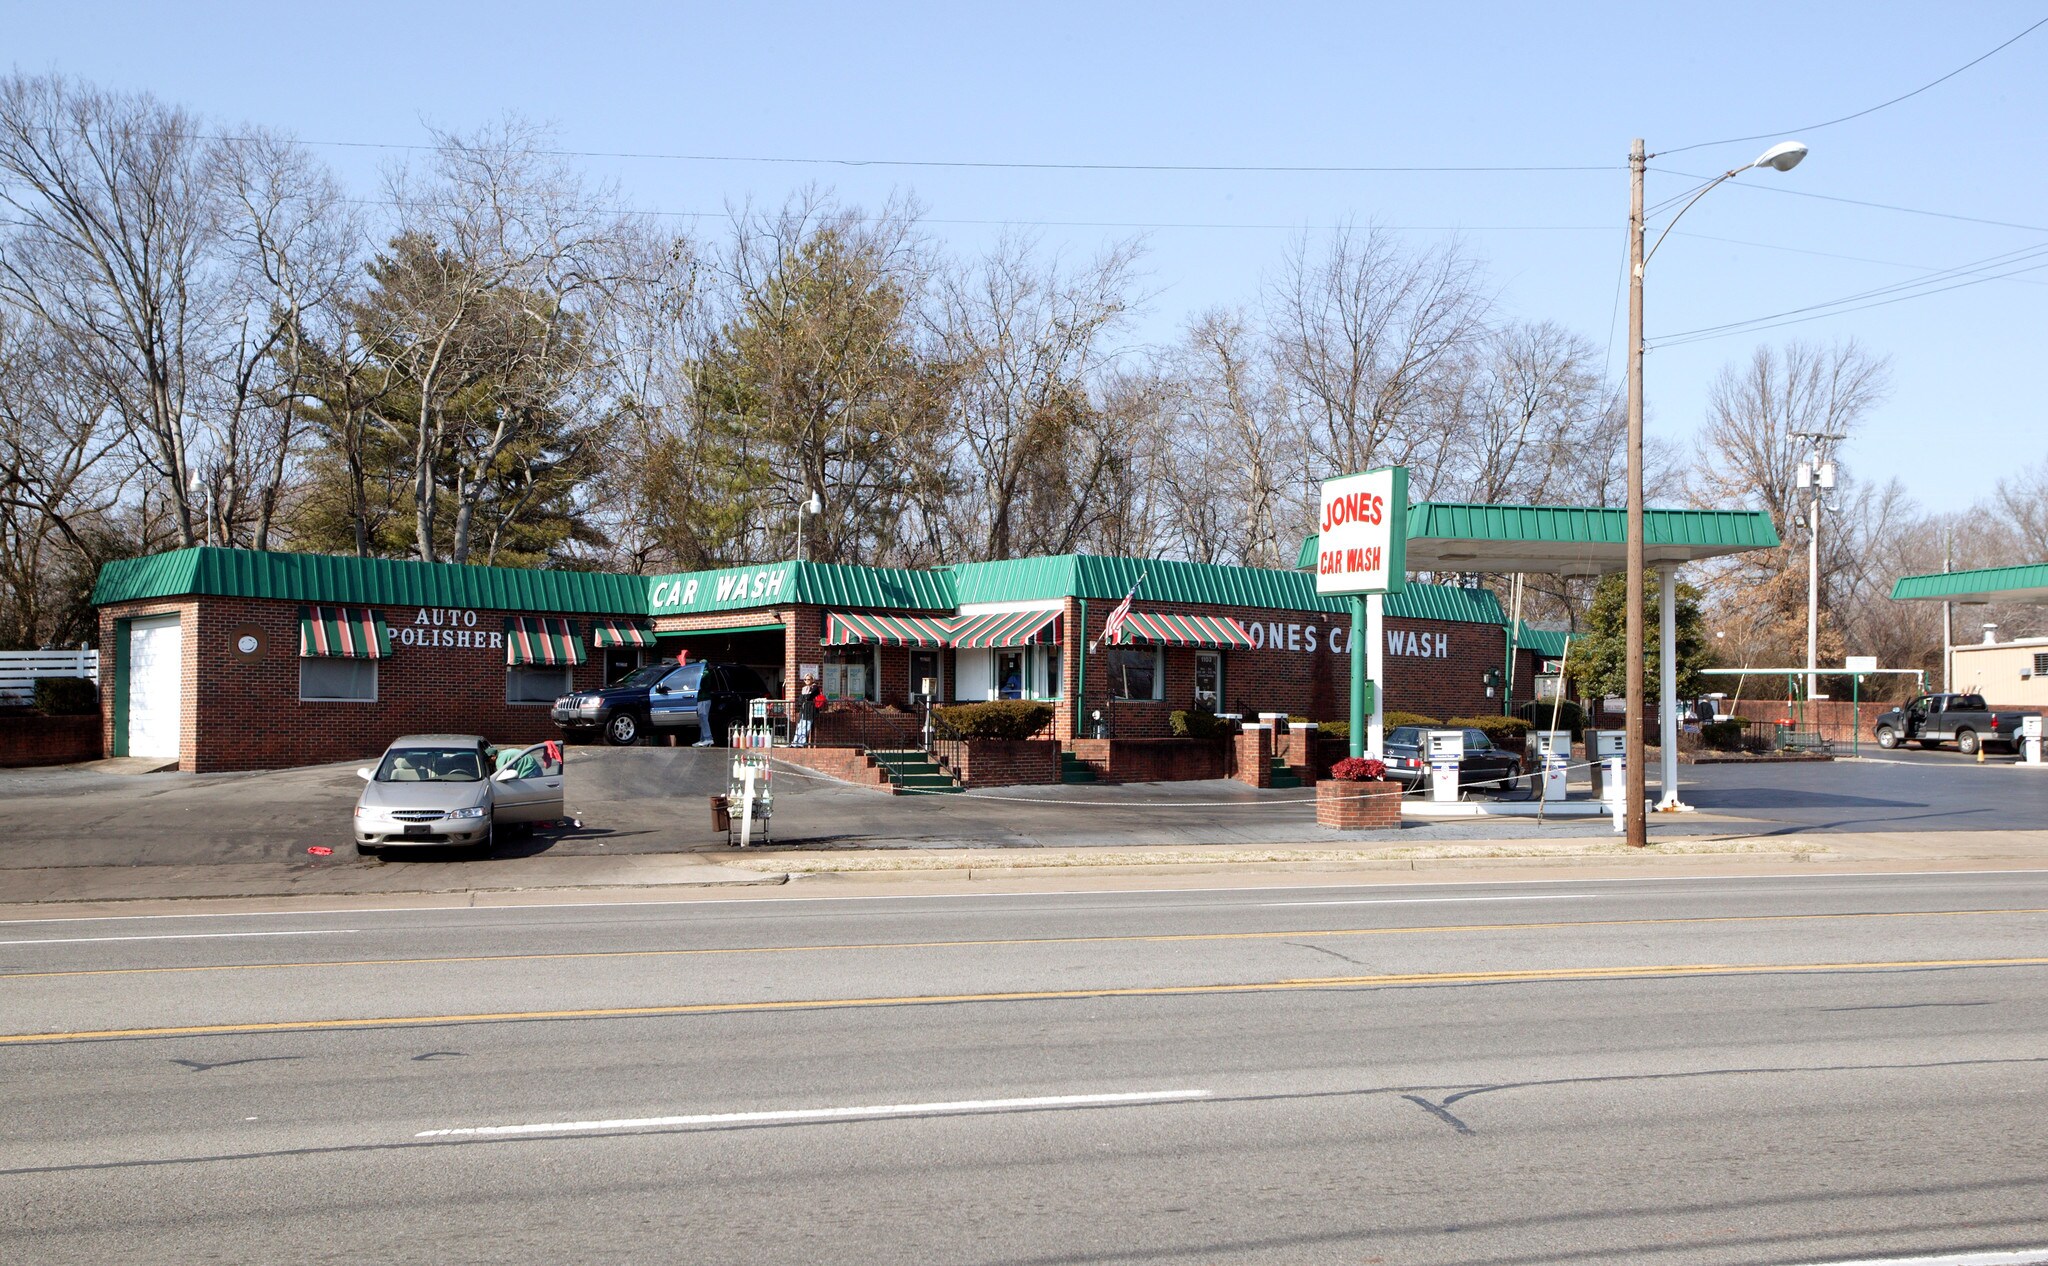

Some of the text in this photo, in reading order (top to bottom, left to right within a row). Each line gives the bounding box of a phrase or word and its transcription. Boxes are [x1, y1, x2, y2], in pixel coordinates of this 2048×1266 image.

[1322, 492, 1383, 532] JONES
[1320, 546, 1381, 575] CAR WASH
[652, 570, 785, 608] CAR WASH
[415, 608, 477, 627] AUTO
[387, 628, 502, 648] POLISHER
[1238, 621, 1317, 653] ONES
[1387, 630, 1447, 658] WASH
